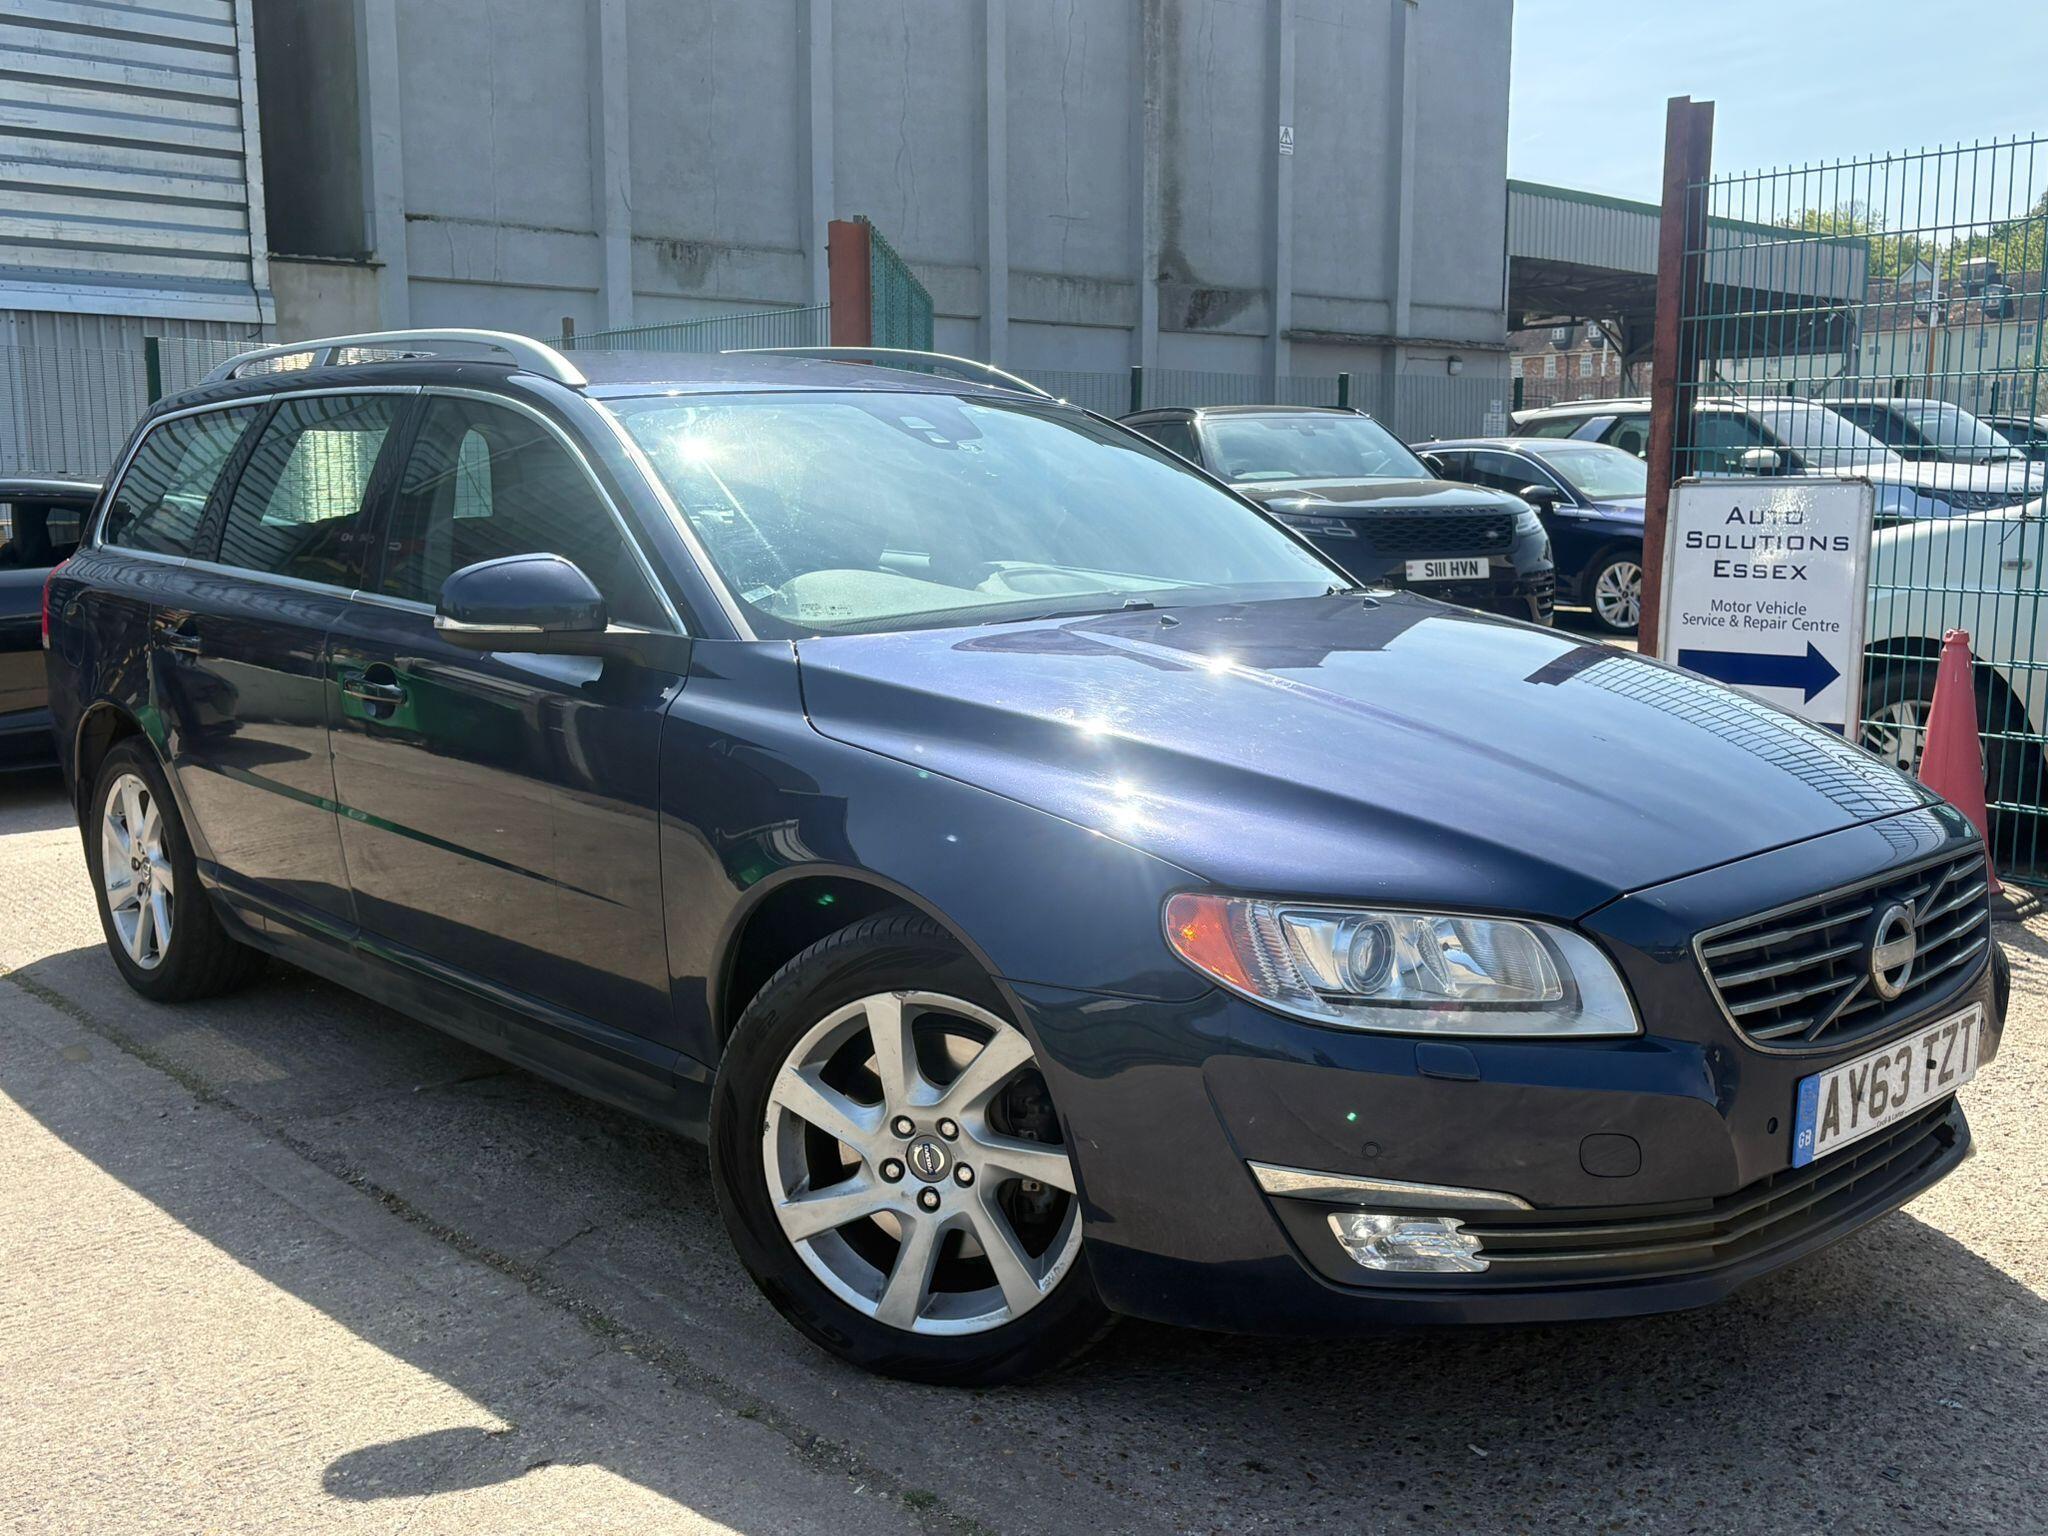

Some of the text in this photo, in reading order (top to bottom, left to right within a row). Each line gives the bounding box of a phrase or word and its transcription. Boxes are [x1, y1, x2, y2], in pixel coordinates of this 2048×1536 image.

[1725, 506, 1804, 525] AUTO
[1685, 531, 1849, 551] SOLUTIONS
[1450, 560, 1478, 577] HVN
[1713, 559, 1807, 580] ESSEX
[1711, 599, 1807, 616] Motor Vehicle
[1682, 612, 1840, 632] Service & Repair Centre
[1819, 1013, 1976, 1143] AY63 TZT
[1799, 1129, 1812, 1148] GB
